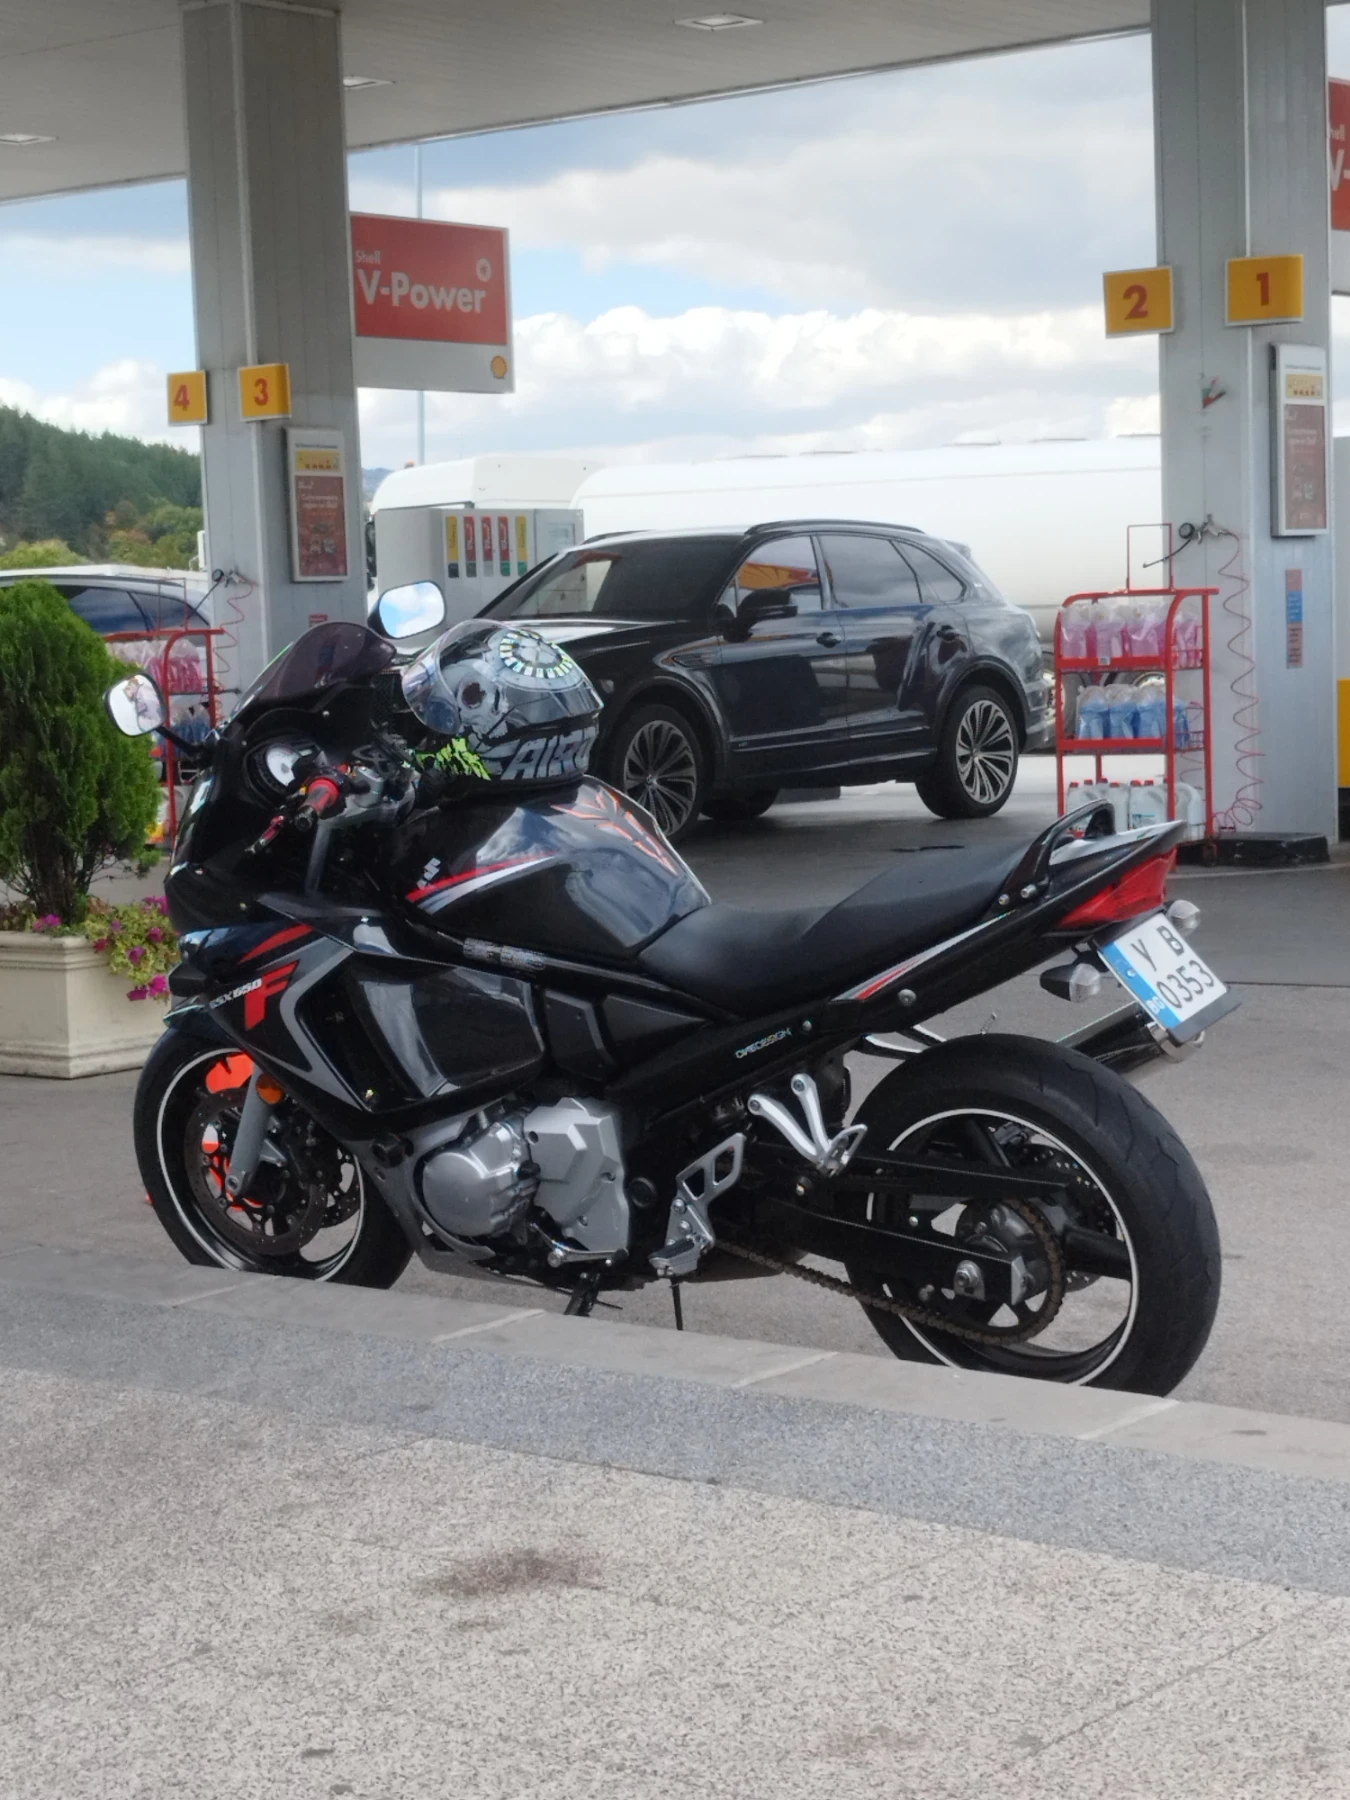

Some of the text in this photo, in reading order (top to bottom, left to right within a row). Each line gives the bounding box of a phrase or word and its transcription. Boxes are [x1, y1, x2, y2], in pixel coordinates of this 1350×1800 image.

[355, 251, 381, 264] Shell
[357, 269, 486, 313] V-Power
[1123, 285, 1148, 320] 2
[1256, 272, 1269, 306] 1
[174, 384, 190, 411] 4
[254, 378, 269, 406] 3
[1130, 925, 1185, 972] Y B
[1156, 959, 1214, 1009] 0353
